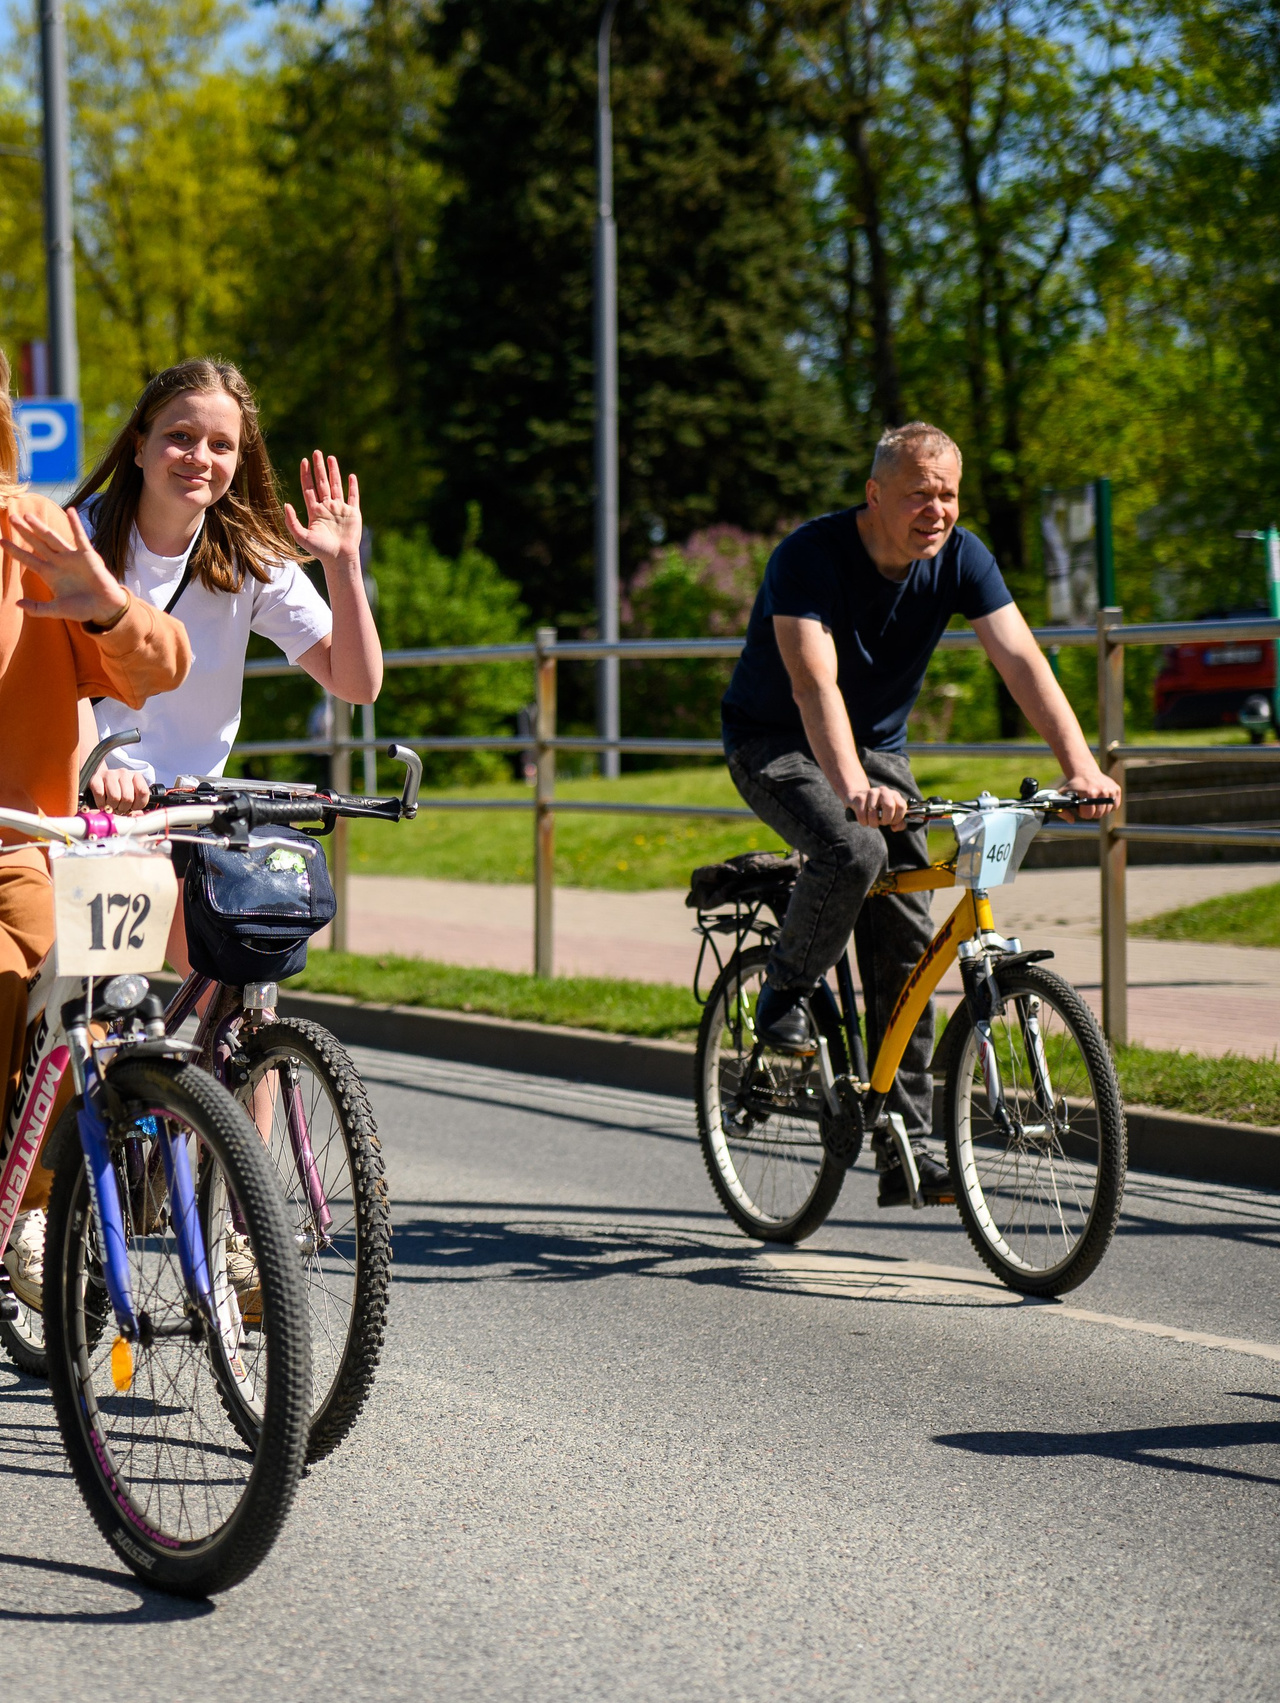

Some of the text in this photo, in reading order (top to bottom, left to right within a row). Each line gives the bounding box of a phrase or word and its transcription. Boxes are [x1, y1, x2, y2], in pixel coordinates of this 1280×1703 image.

[19, 408, 67, 478] P
[986, 843, 1011, 863] 460
[86, 892, 151, 951] 172
